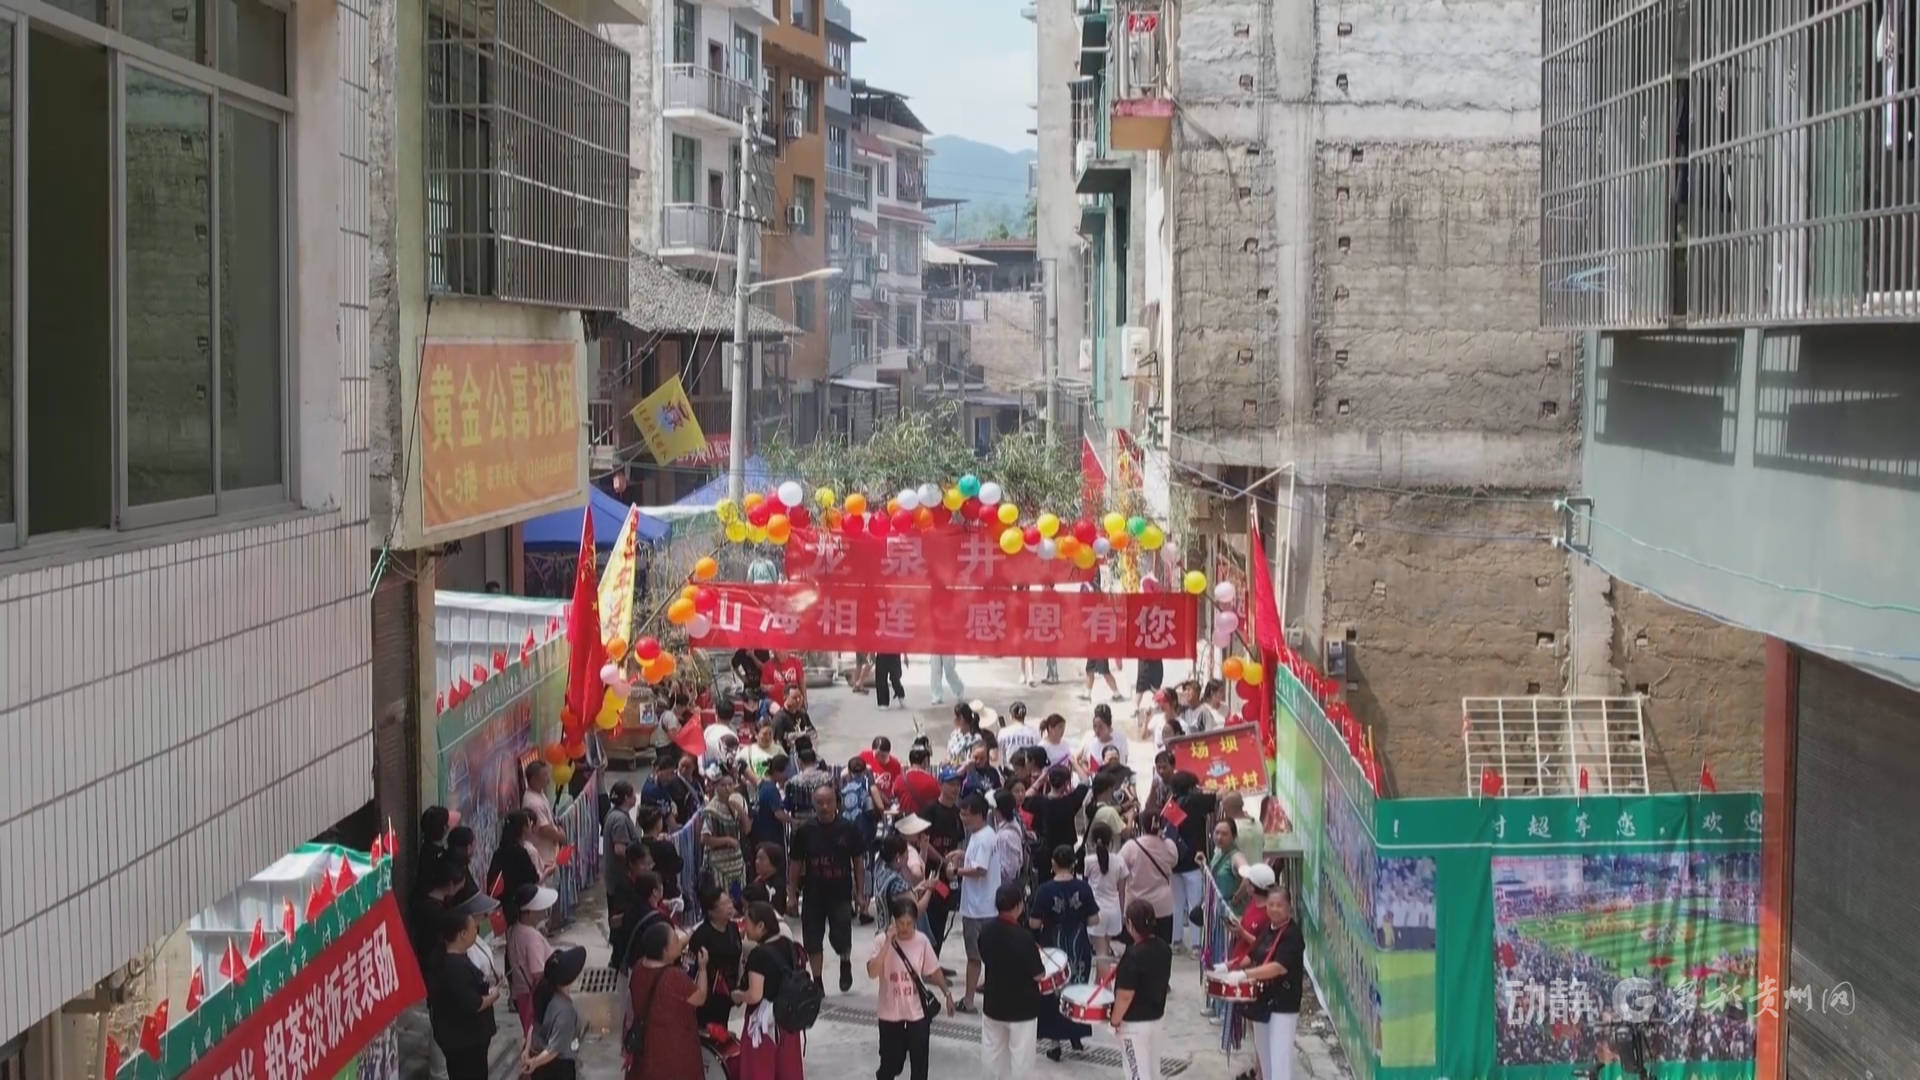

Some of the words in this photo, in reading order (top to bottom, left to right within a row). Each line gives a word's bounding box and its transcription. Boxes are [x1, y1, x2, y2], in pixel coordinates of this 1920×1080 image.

[430, 362, 576, 451] 黄金公寓招租
[964, 601, 1176, 650] 感恩有您
[264, 920, 400, 1080] 粗茶淡饭表衷肠
